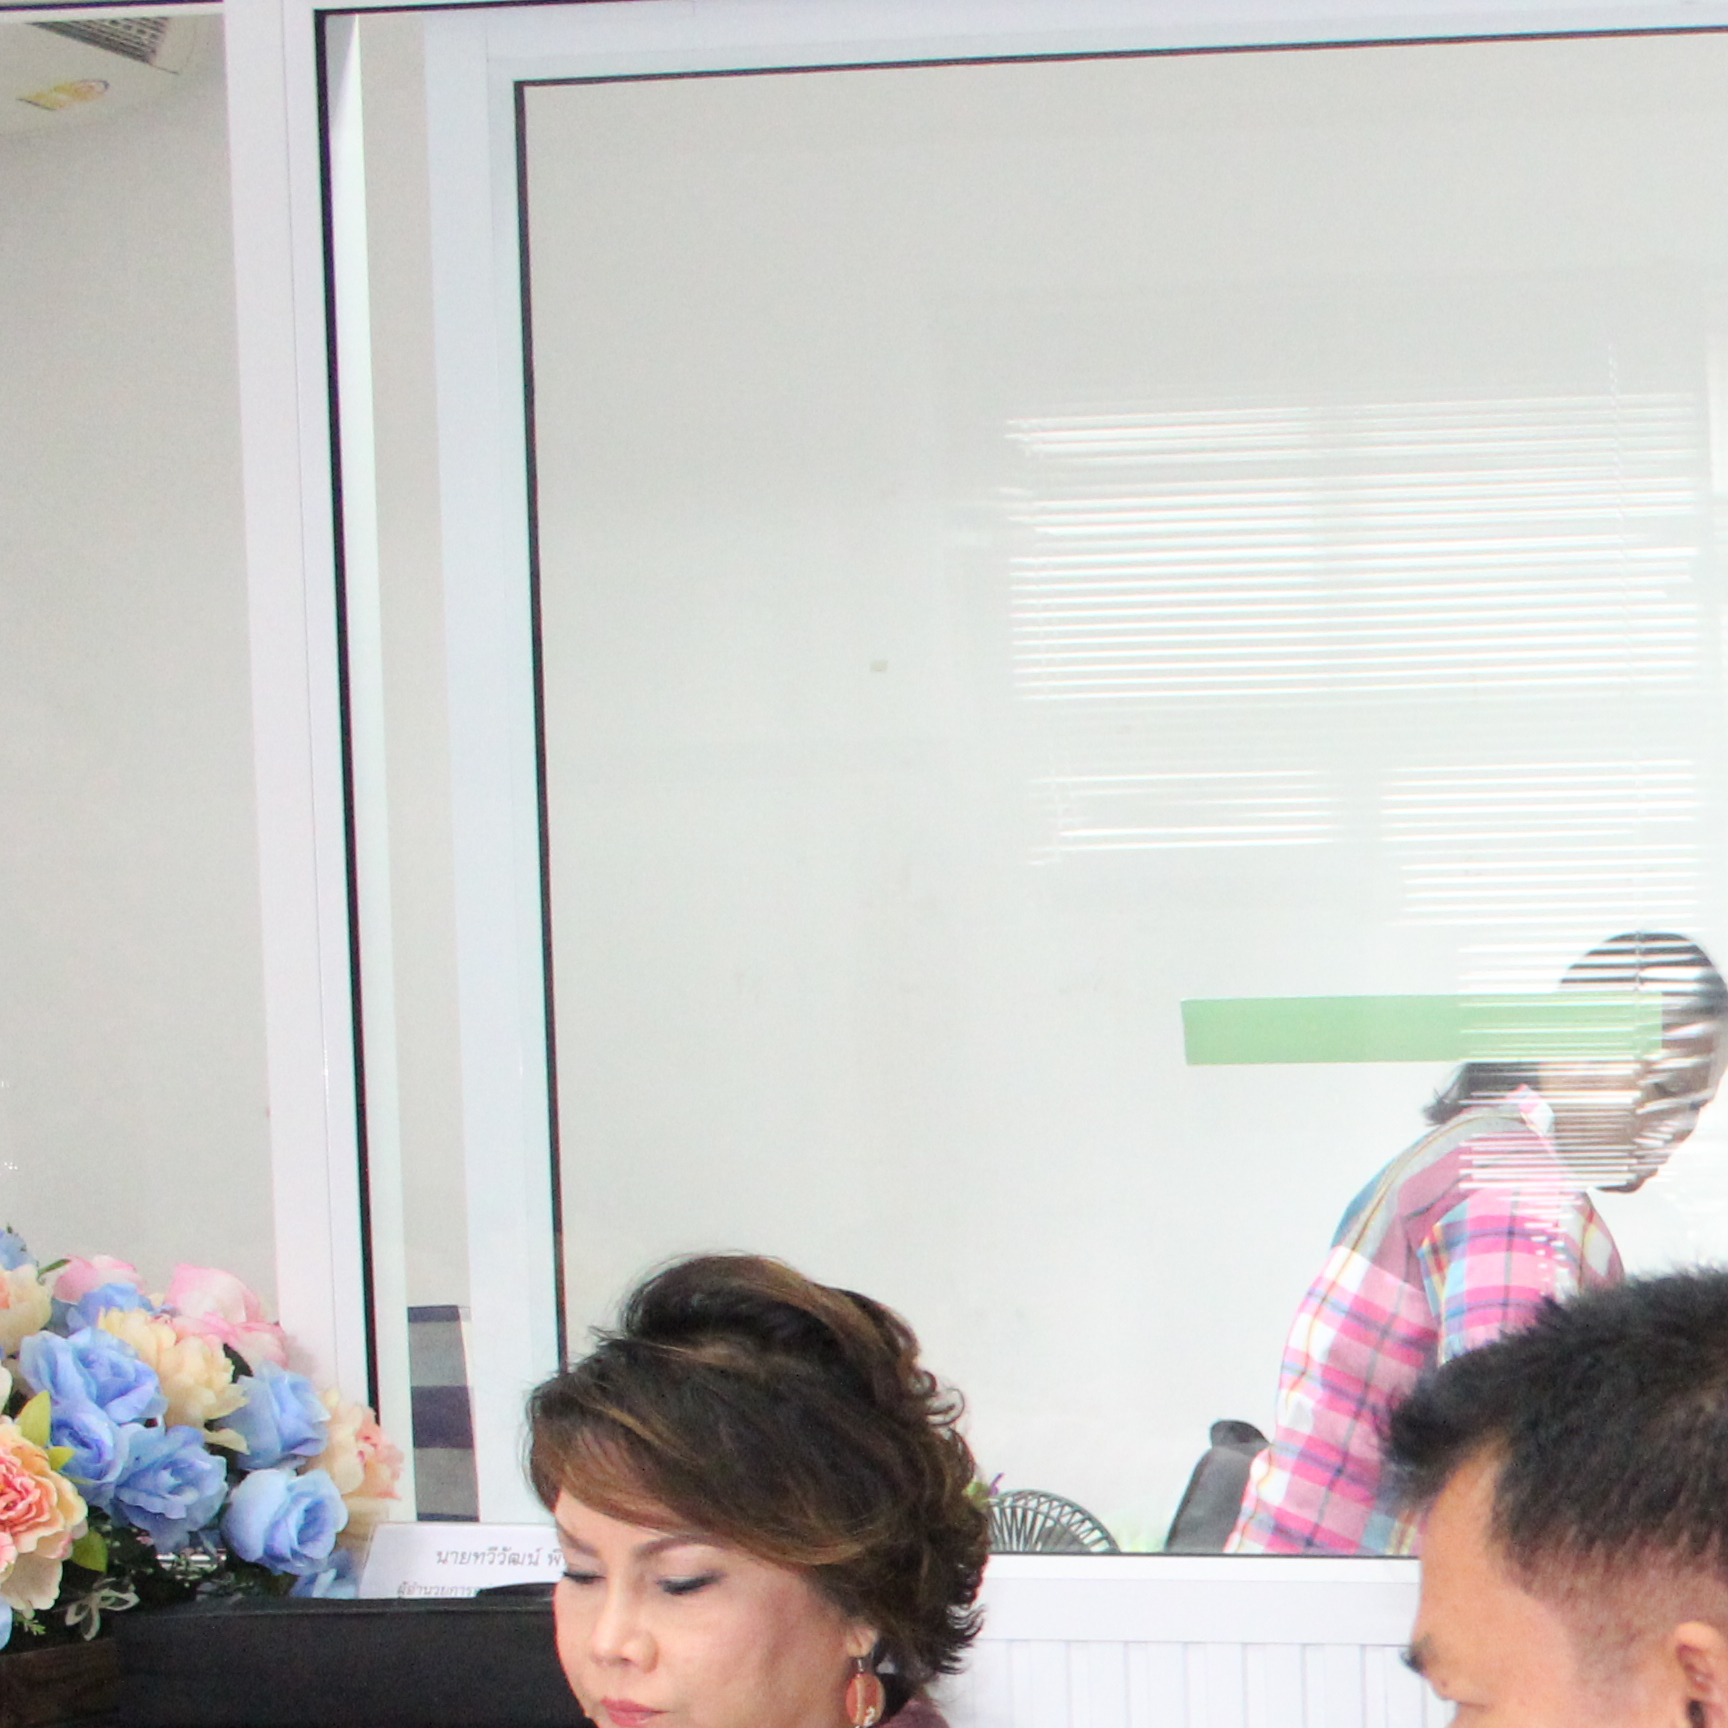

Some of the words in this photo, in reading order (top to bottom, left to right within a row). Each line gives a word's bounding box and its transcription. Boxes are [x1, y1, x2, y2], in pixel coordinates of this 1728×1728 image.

[436, 1545, 544, 1566] นายทวีวัฒน์
[547, 1547, 566, 1566] พิ
[396, 1581, 481, 1598] ผู้อำนวยการ
